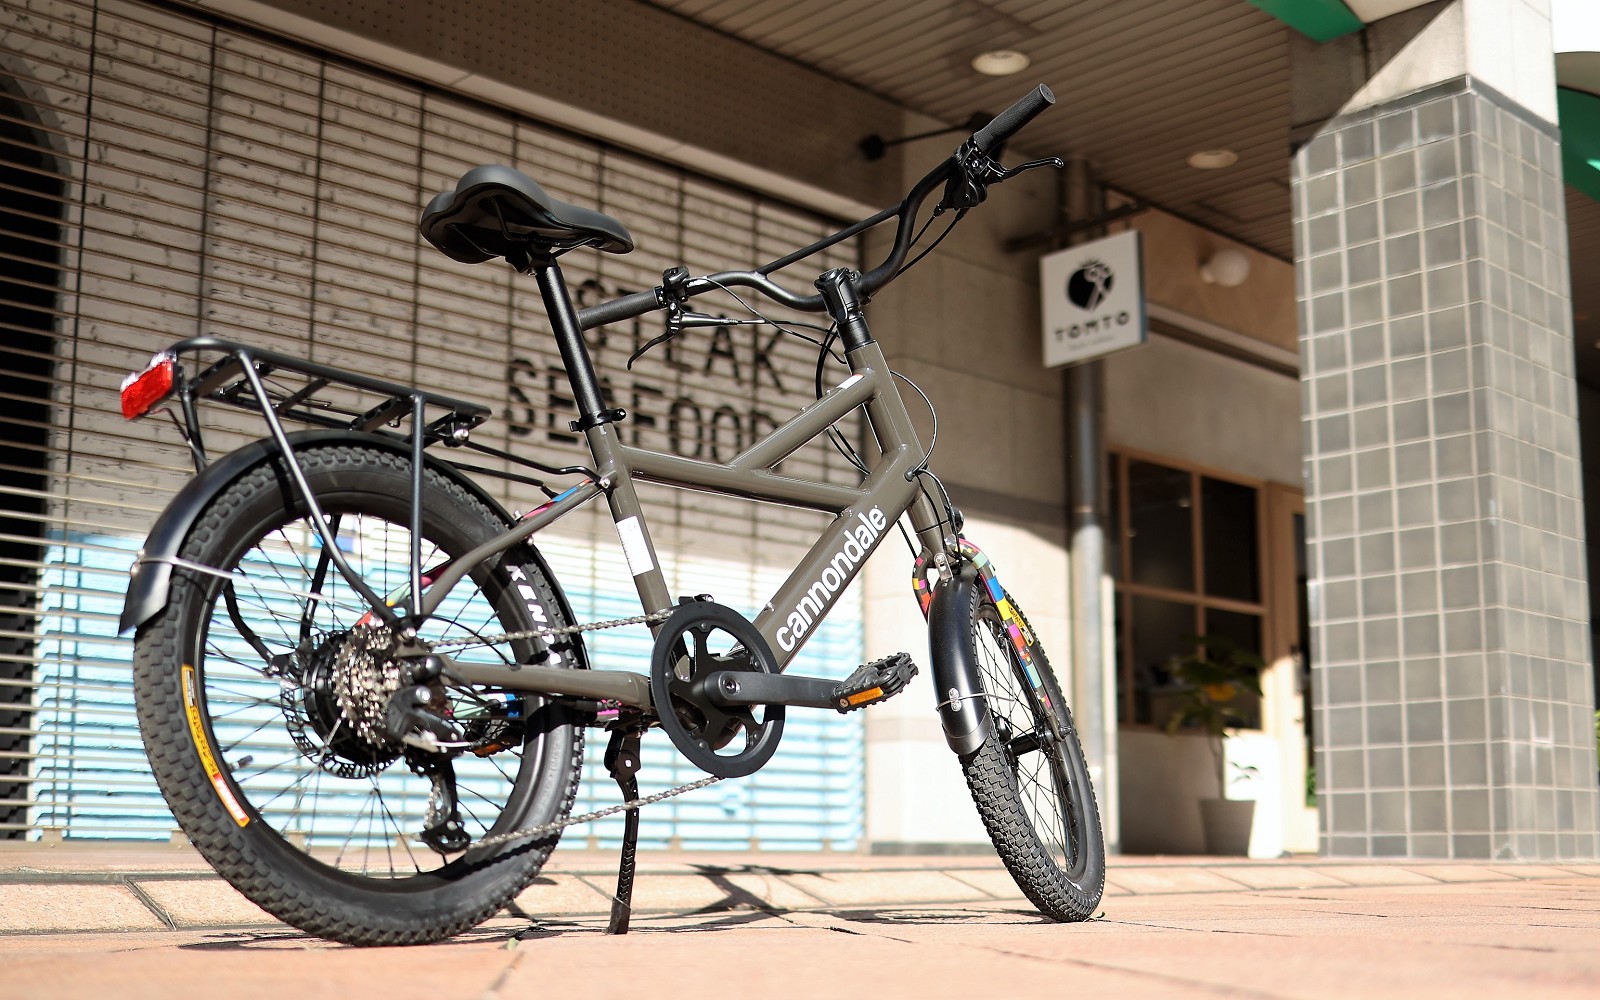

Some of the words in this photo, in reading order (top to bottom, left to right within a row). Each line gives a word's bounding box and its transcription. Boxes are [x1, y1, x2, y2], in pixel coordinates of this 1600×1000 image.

[1055, 311, 1130, 342] TOMTO
[505, 565, 562, 665] KENDA
[776, 506, 887, 652] cannondale
